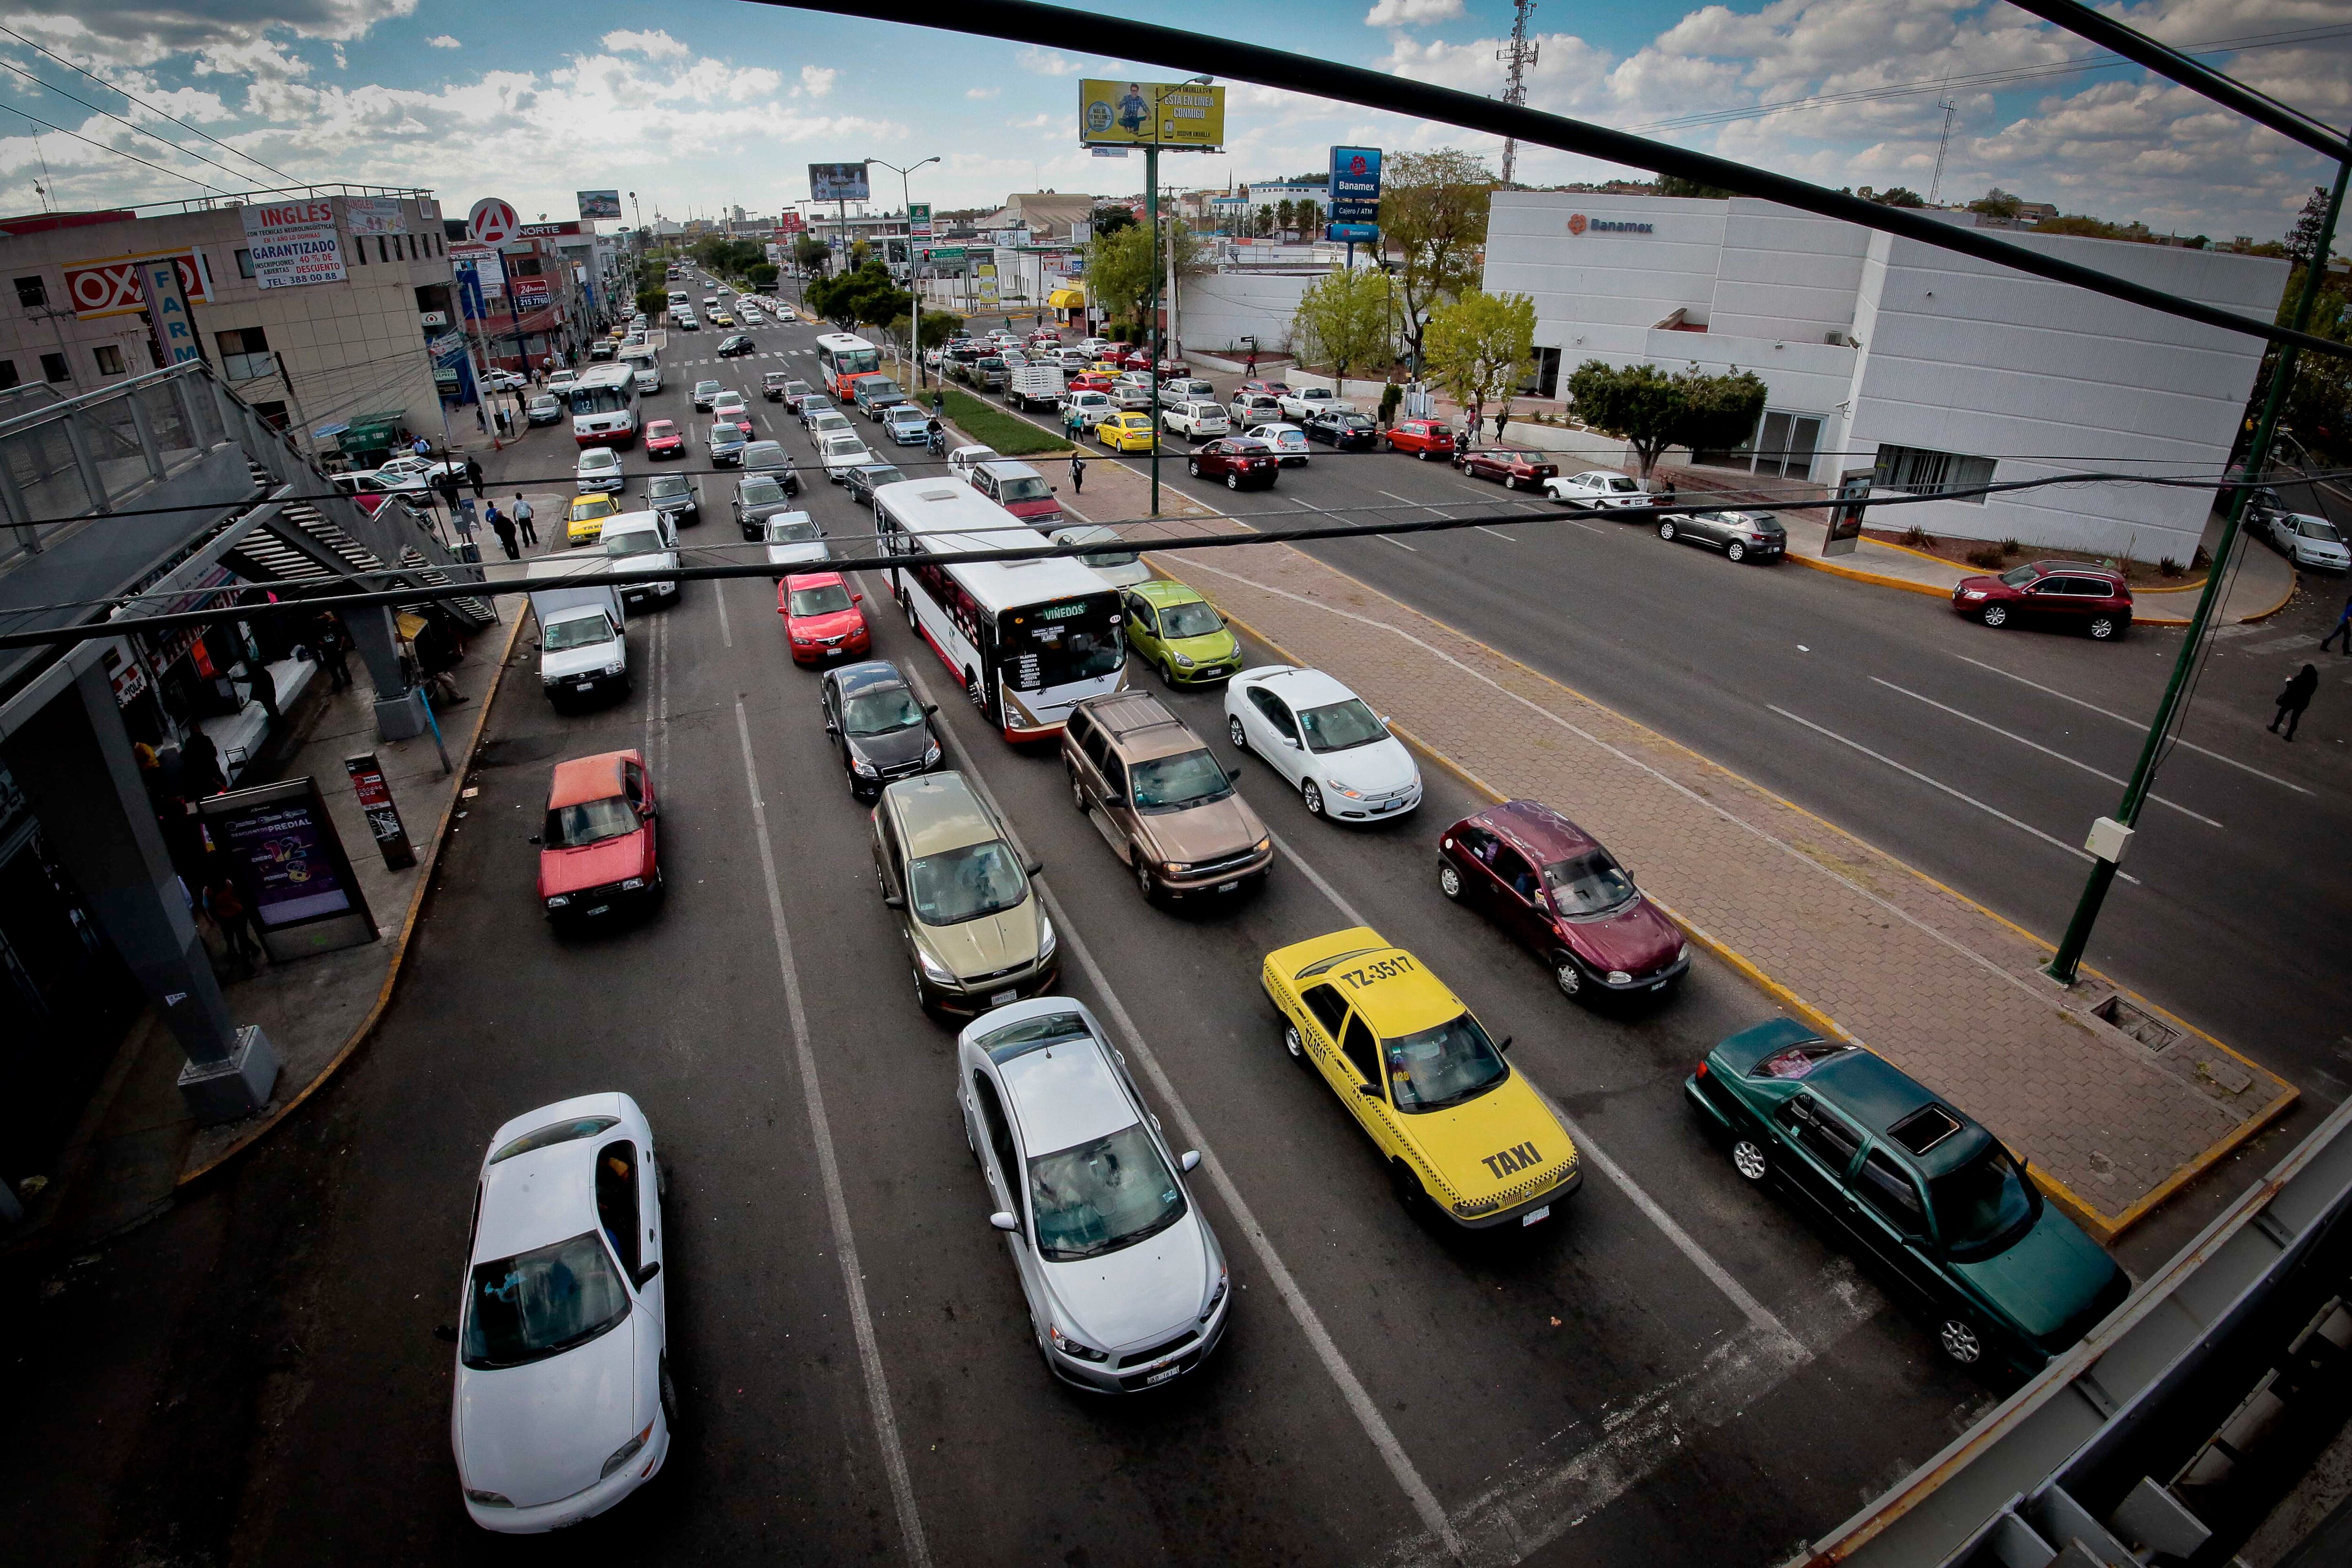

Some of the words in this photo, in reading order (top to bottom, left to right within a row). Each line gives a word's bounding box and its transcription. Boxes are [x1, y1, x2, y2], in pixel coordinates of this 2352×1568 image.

[1183, 96, 1192, 106] EN
[1174, 108, 1205, 119] CONMIGO
[1339, 181, 1375, 191] Banamex
[260, 200, 332, 227] INGLÉS
[518, 225, 560, 236] NORTE
[1591, 218, 1653, 233] Banamex
[259, 228, 283, 236] TECNICAS
[253, 240, 335, 260] GARANTIZADO
[311, 254, 320, 263] %
[322, 253, 333, 261] DE
[255, 259, 294, 270] INSCRIPCIONES
[296, 262, 340, 274] DESCUENTO
[267, 278, 286, 287] TEL:
[289, 275, 307, 284] 388
[1045, 605, 1084, 621] VIÑEDOS
[268, 819, 312, 833] PREDIAL
[251, 854, 273, 863] ENERO
[263, 836, 307, 863] 12
[286, 860, 311, 883] 8
[1340, 955, 1414, 989] TZ-3517
[1392, 1070, 1410, 1081] 428
[1481, 1141, 1543, 1179] TAXI
